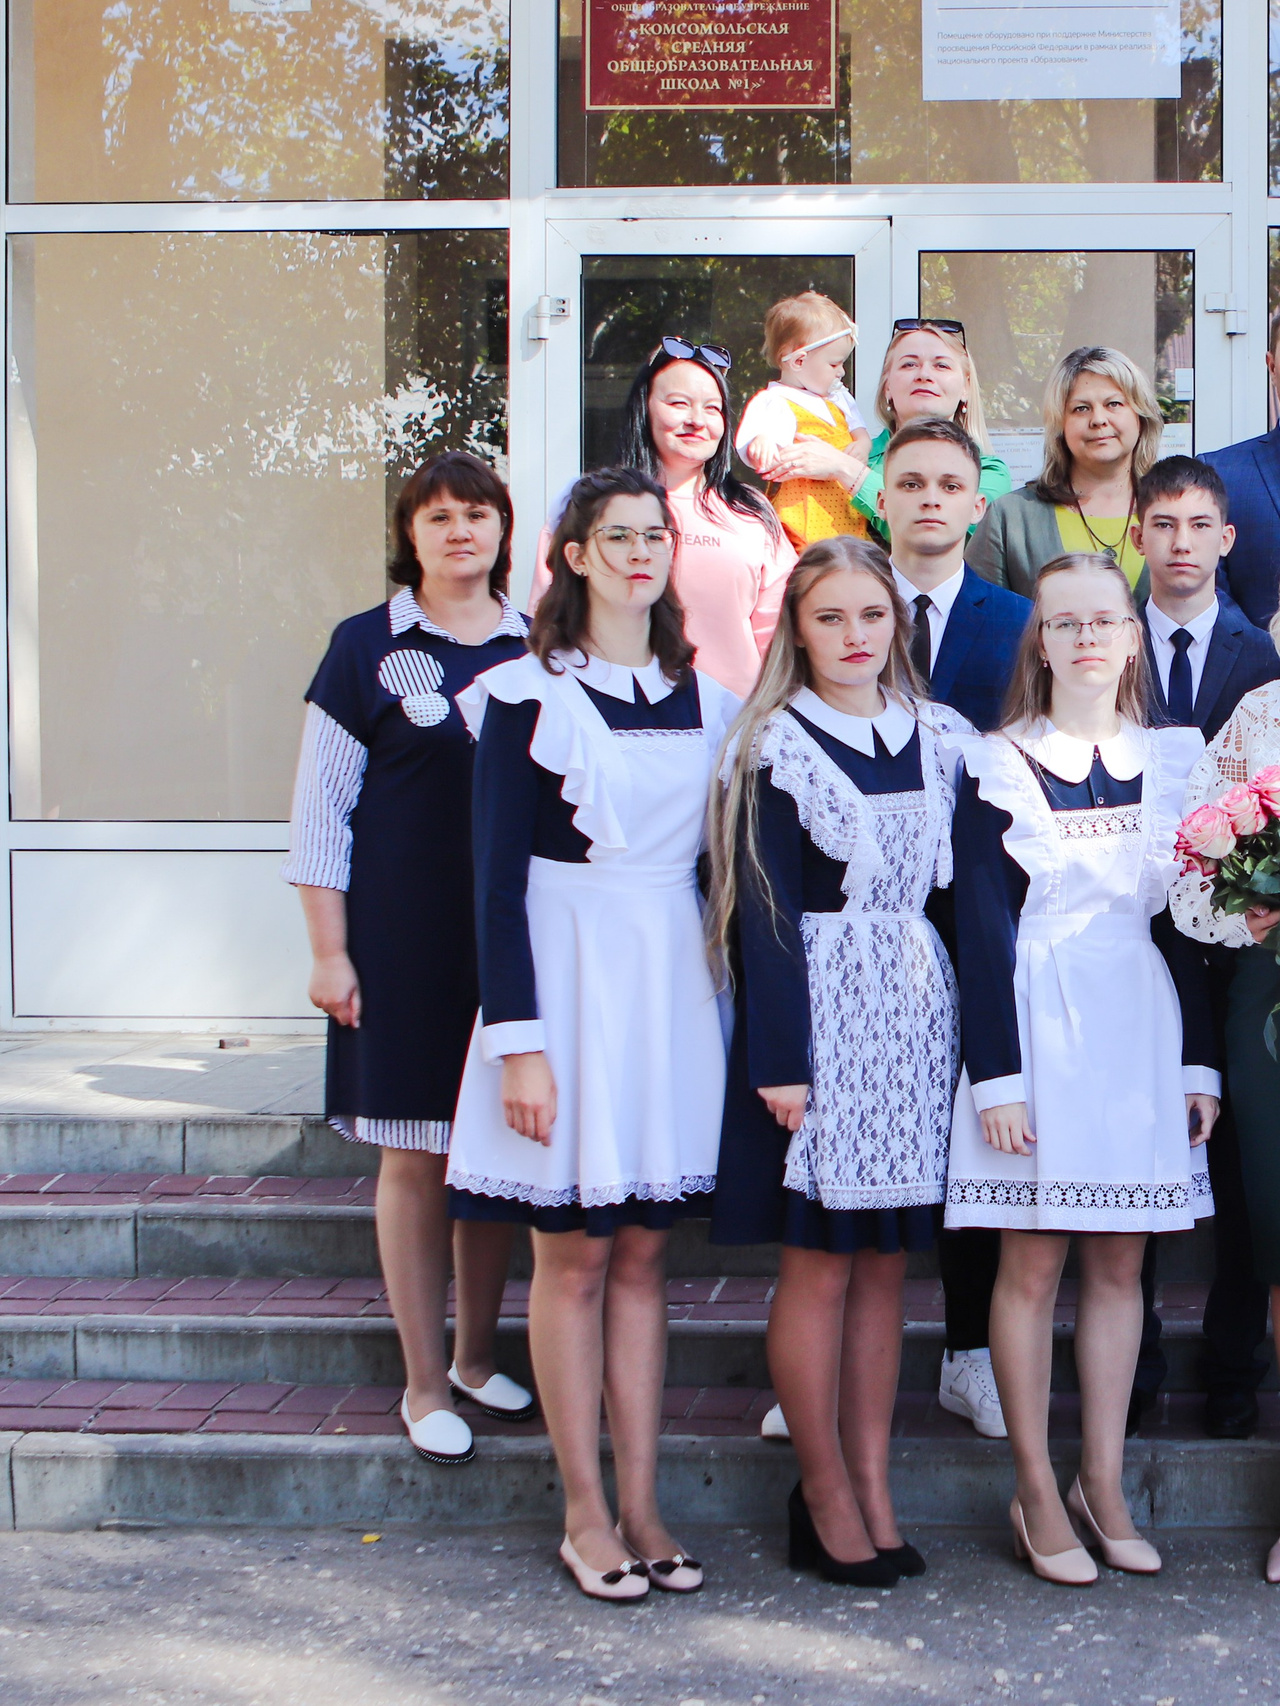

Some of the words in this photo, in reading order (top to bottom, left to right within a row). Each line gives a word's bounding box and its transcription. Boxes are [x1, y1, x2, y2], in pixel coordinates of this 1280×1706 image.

[937, 31, 983, 40] Помещение
[985, 30, 1034, 40] оборудовано
[1098, 30, 1151, 38] Министерства
[671, 41, 746, 54] СРЕДНЯЯ
[937, 44, 989, 52] просвещения
[991, 43, 1036, 51] Российской
[1037, 43, 1082, 51] Федерации
[1030, 55, 1088, 64] «Образование»
[607, 59, 813, 73] ОБЩЕОБРАЗОВАТЕЛЬНАЯ
[660, 78, 721, 90] ШКОЛА
[728, 78, 761, 90] №1»
